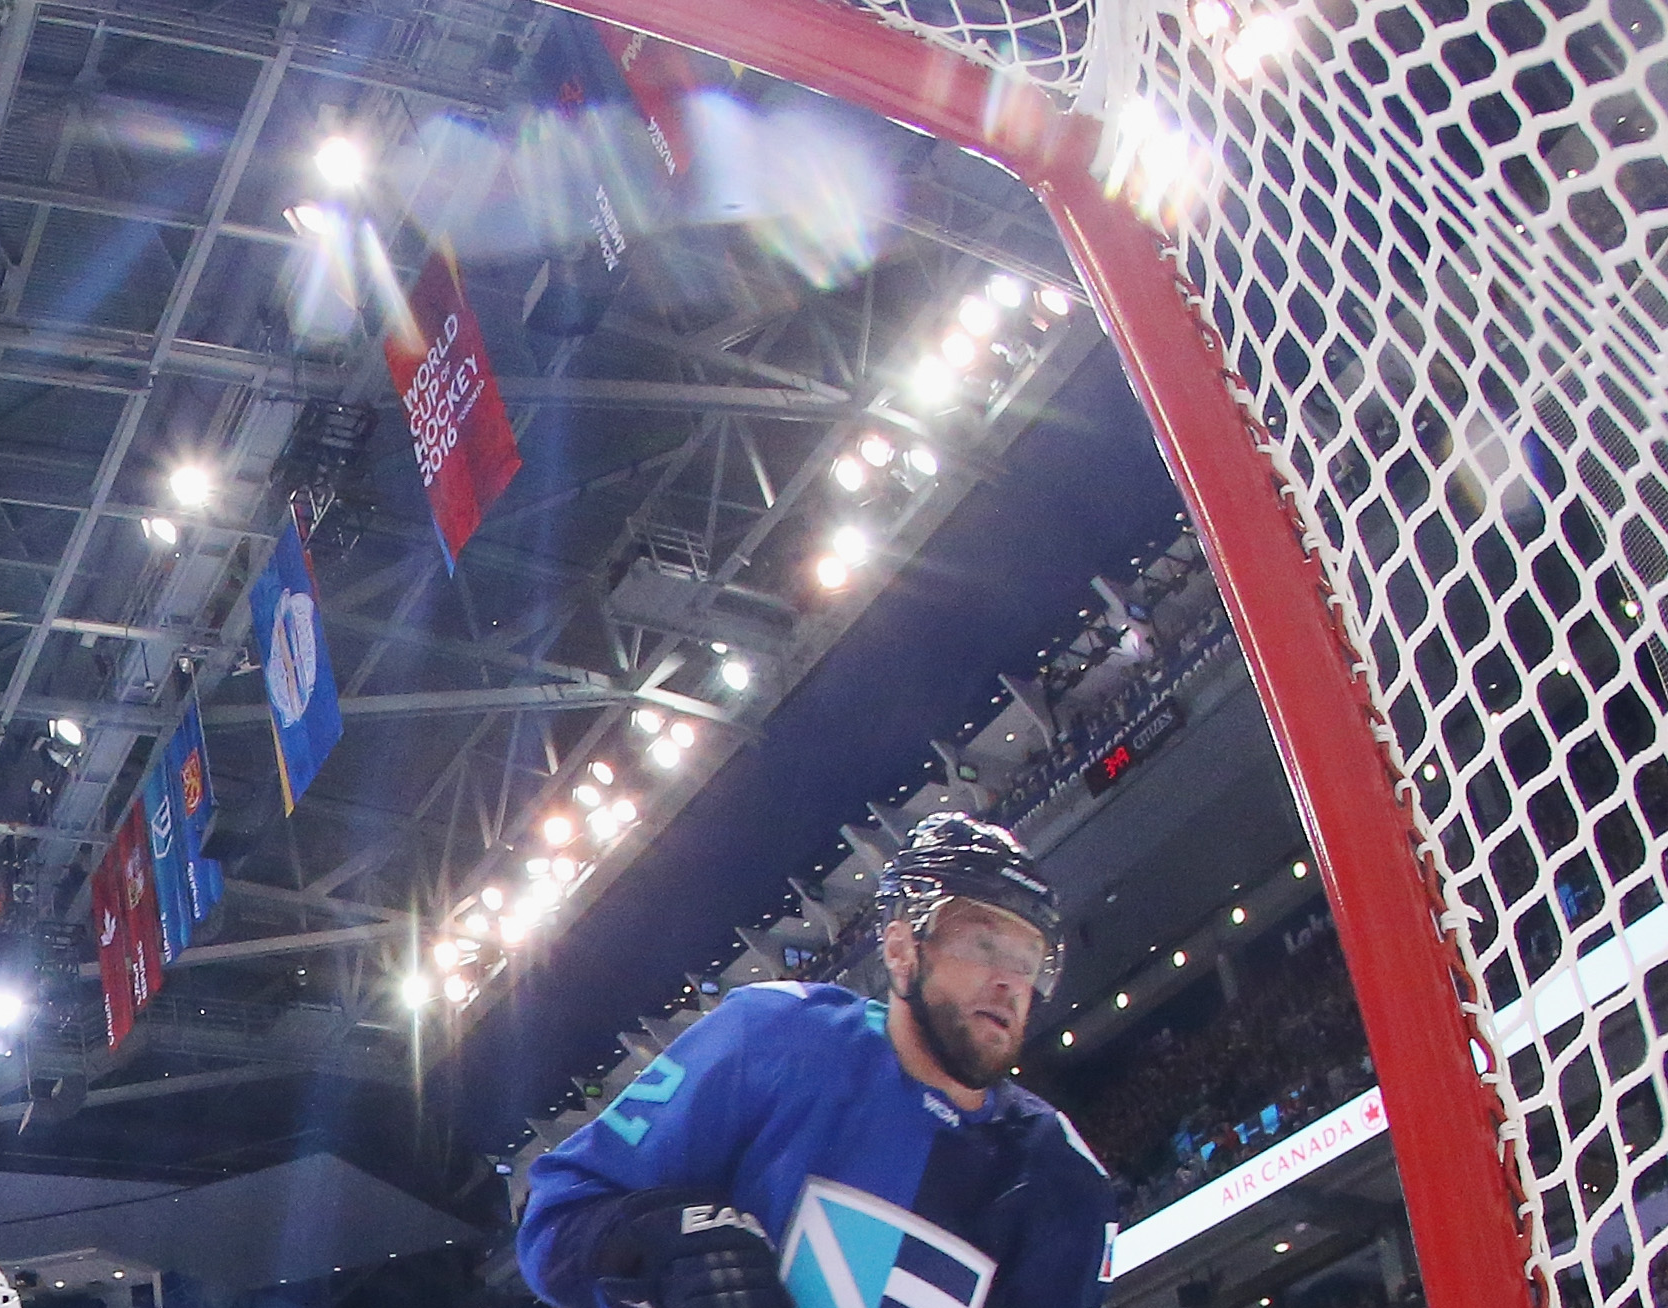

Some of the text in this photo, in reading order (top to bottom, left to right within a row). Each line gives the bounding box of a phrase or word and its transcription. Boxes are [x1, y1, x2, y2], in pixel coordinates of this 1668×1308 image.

[402, 312, 459, 413] WORLD
[409, 376, 440, 438] CUP
[413, 354, 479, 465] HOCKEY
[420, 421, 459, 488] 2016
[1221, 1119, 1355, 1207] AIR CANADA
